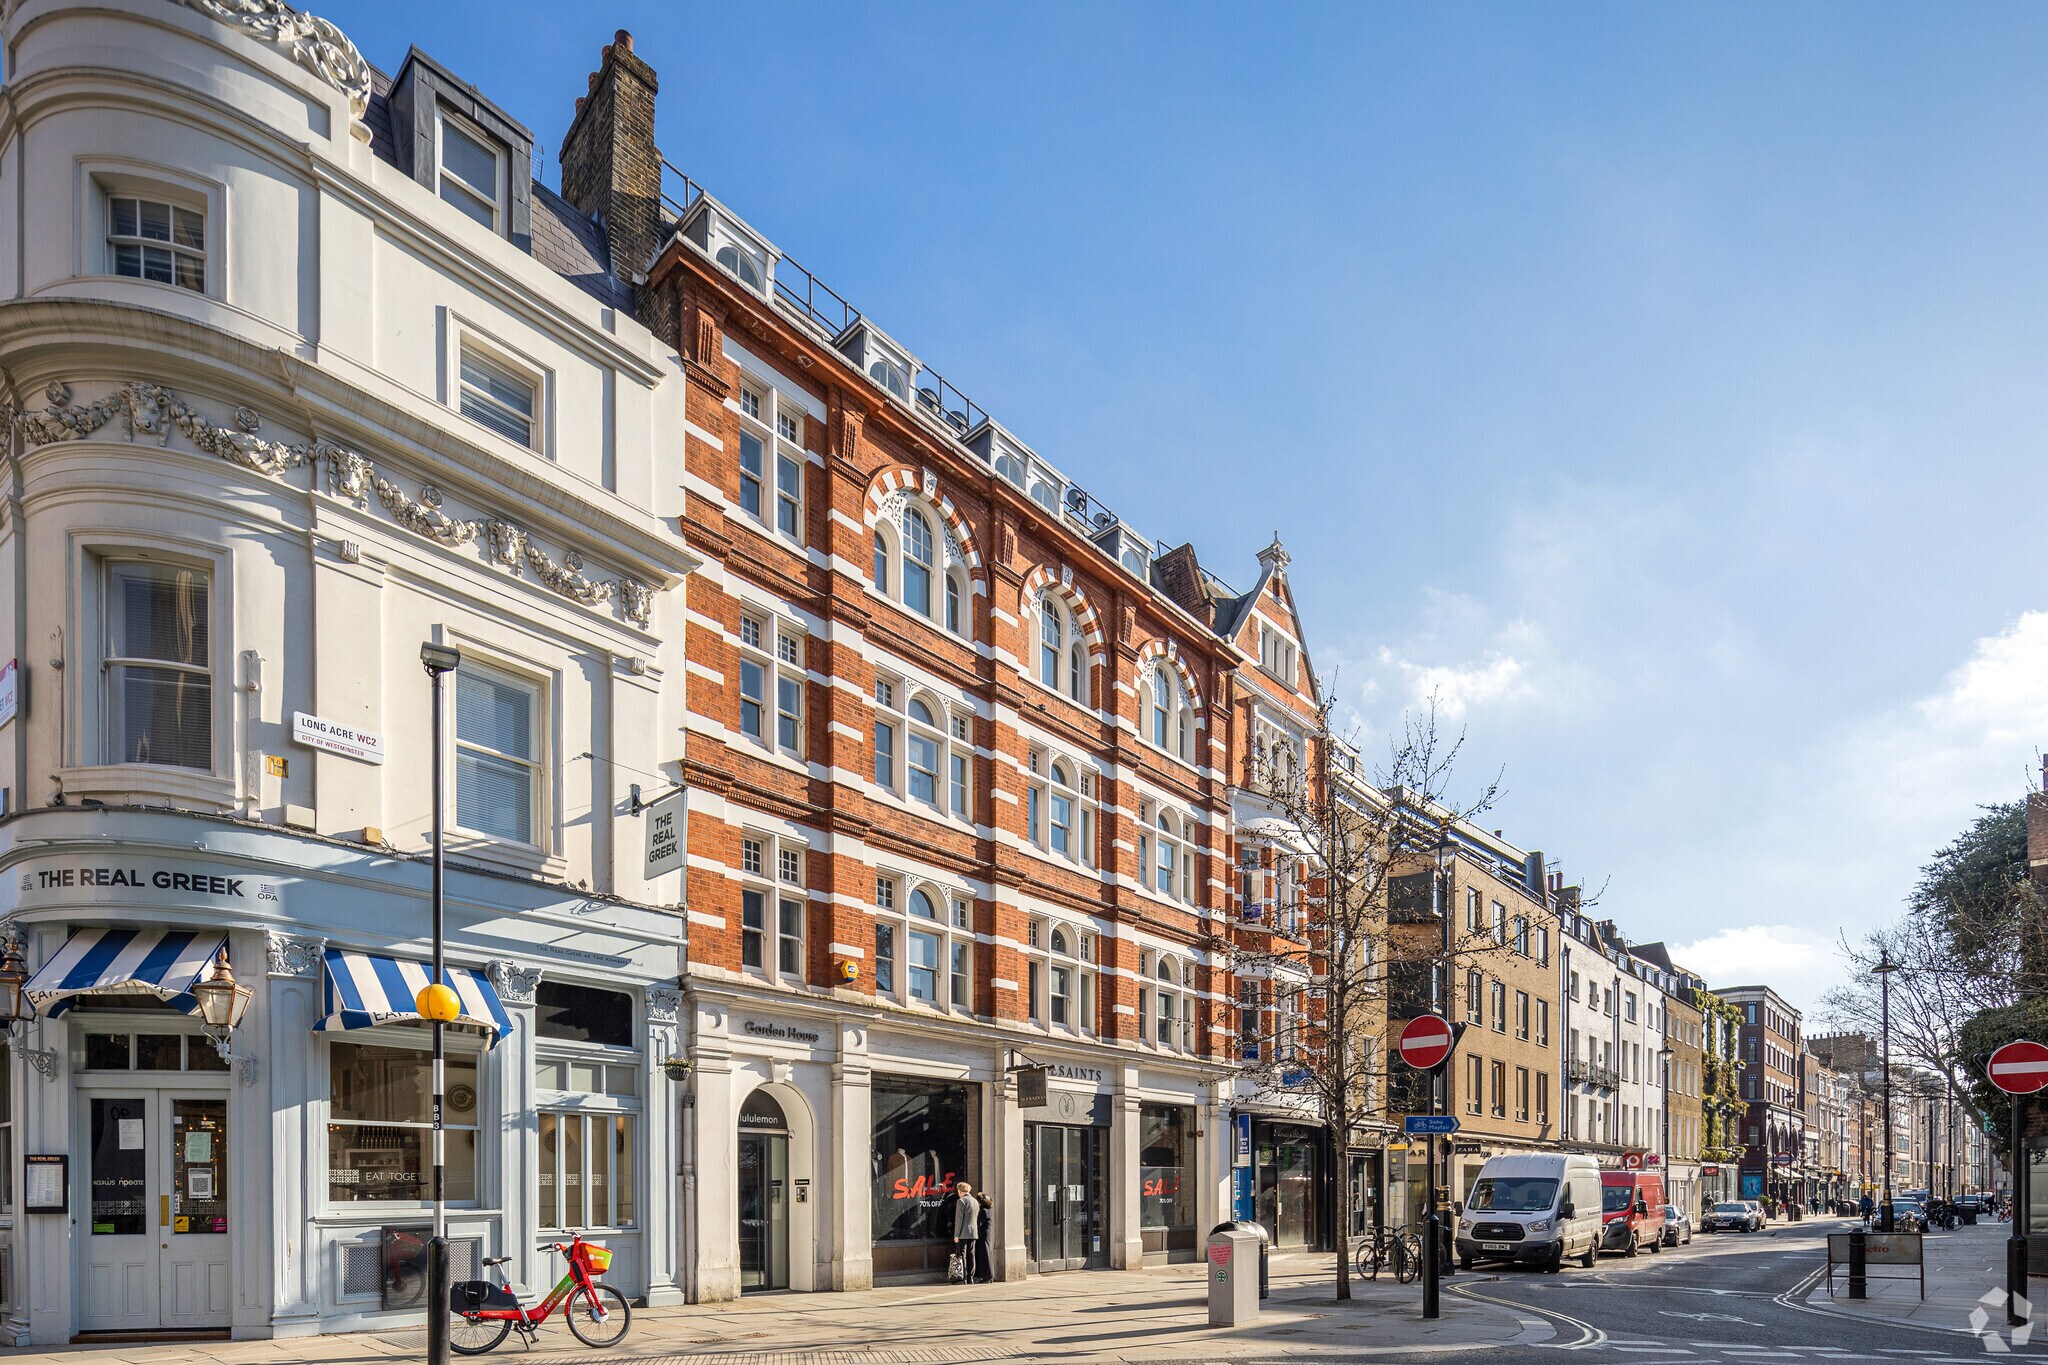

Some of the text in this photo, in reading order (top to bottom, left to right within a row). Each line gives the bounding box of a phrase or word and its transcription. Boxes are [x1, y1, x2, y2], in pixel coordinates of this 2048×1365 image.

[301, 717, 377, 747] LONG ACRE WC2
[301, 734, 365, 757] CITY OF WESTMINSTER
[654, 811, 673, 830] THE
[652, 827, 676, 847] REAL
[648, 841, 678, 863] GREEK
[38, 868, 245, 898] THE REAL GREEK
[257, 892, 279, 902] OPA
[550, 947, 565, 955] Real
[565, 949, 582, 958] Greek
[744, 1021, 820, 1043] Garden House
[739, 1113, 779, 1124] lululemon
[1409, 1149, 1426, 1157] AR
[365, 1172, 386, 1181] EAT.
[919, 1200, 931, 1208] 70%
[1865, 1245, 1889, 1253] etro
